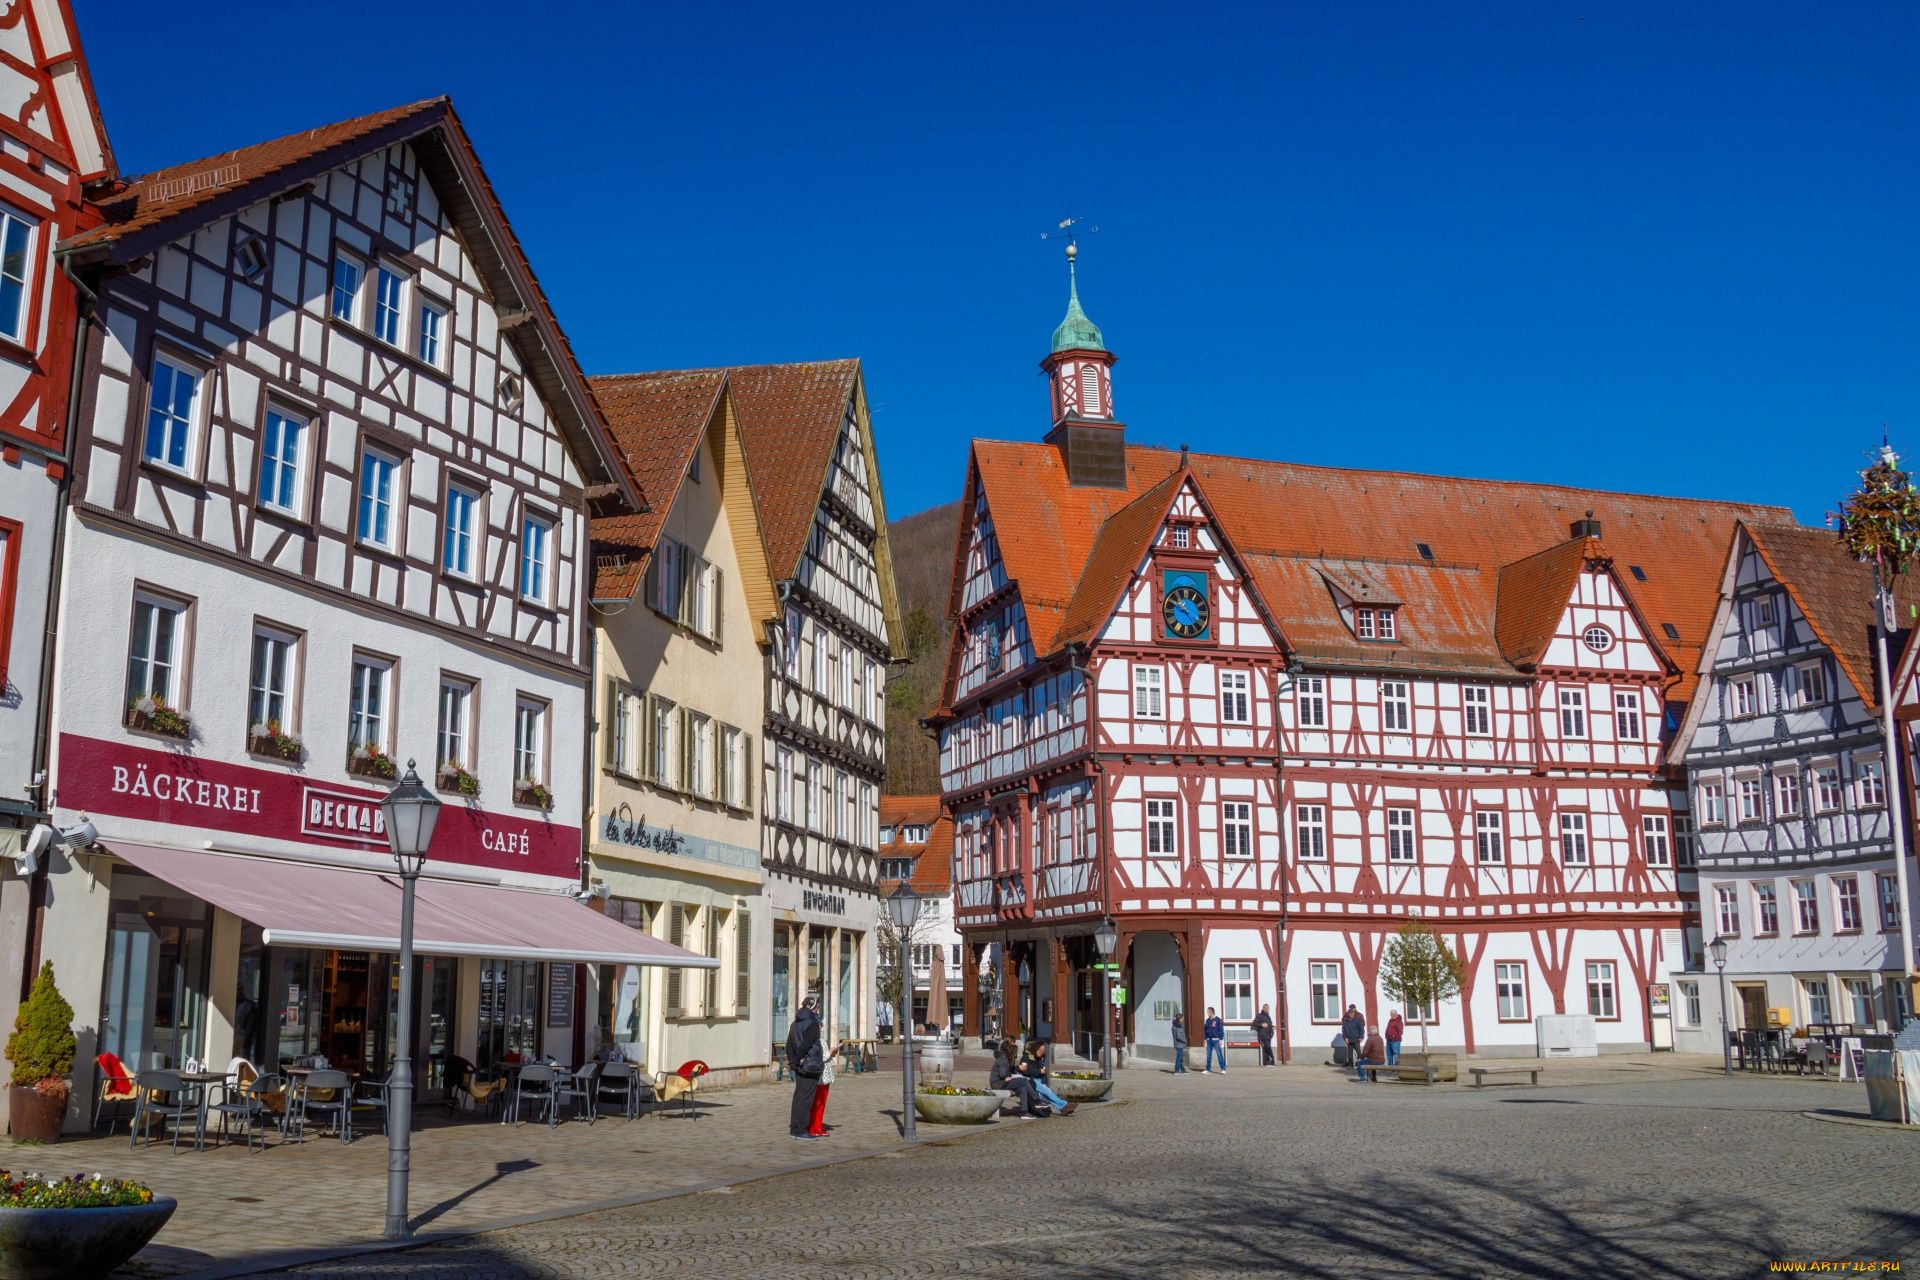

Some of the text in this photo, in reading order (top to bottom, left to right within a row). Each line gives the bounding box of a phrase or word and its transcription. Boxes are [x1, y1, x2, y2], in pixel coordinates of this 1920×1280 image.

[111, 762, 261, 814] BÄCKEREI
[481, 828, 530, 855] CAFÉ
[803, 890, 845, 916] BEWOHNBAR
